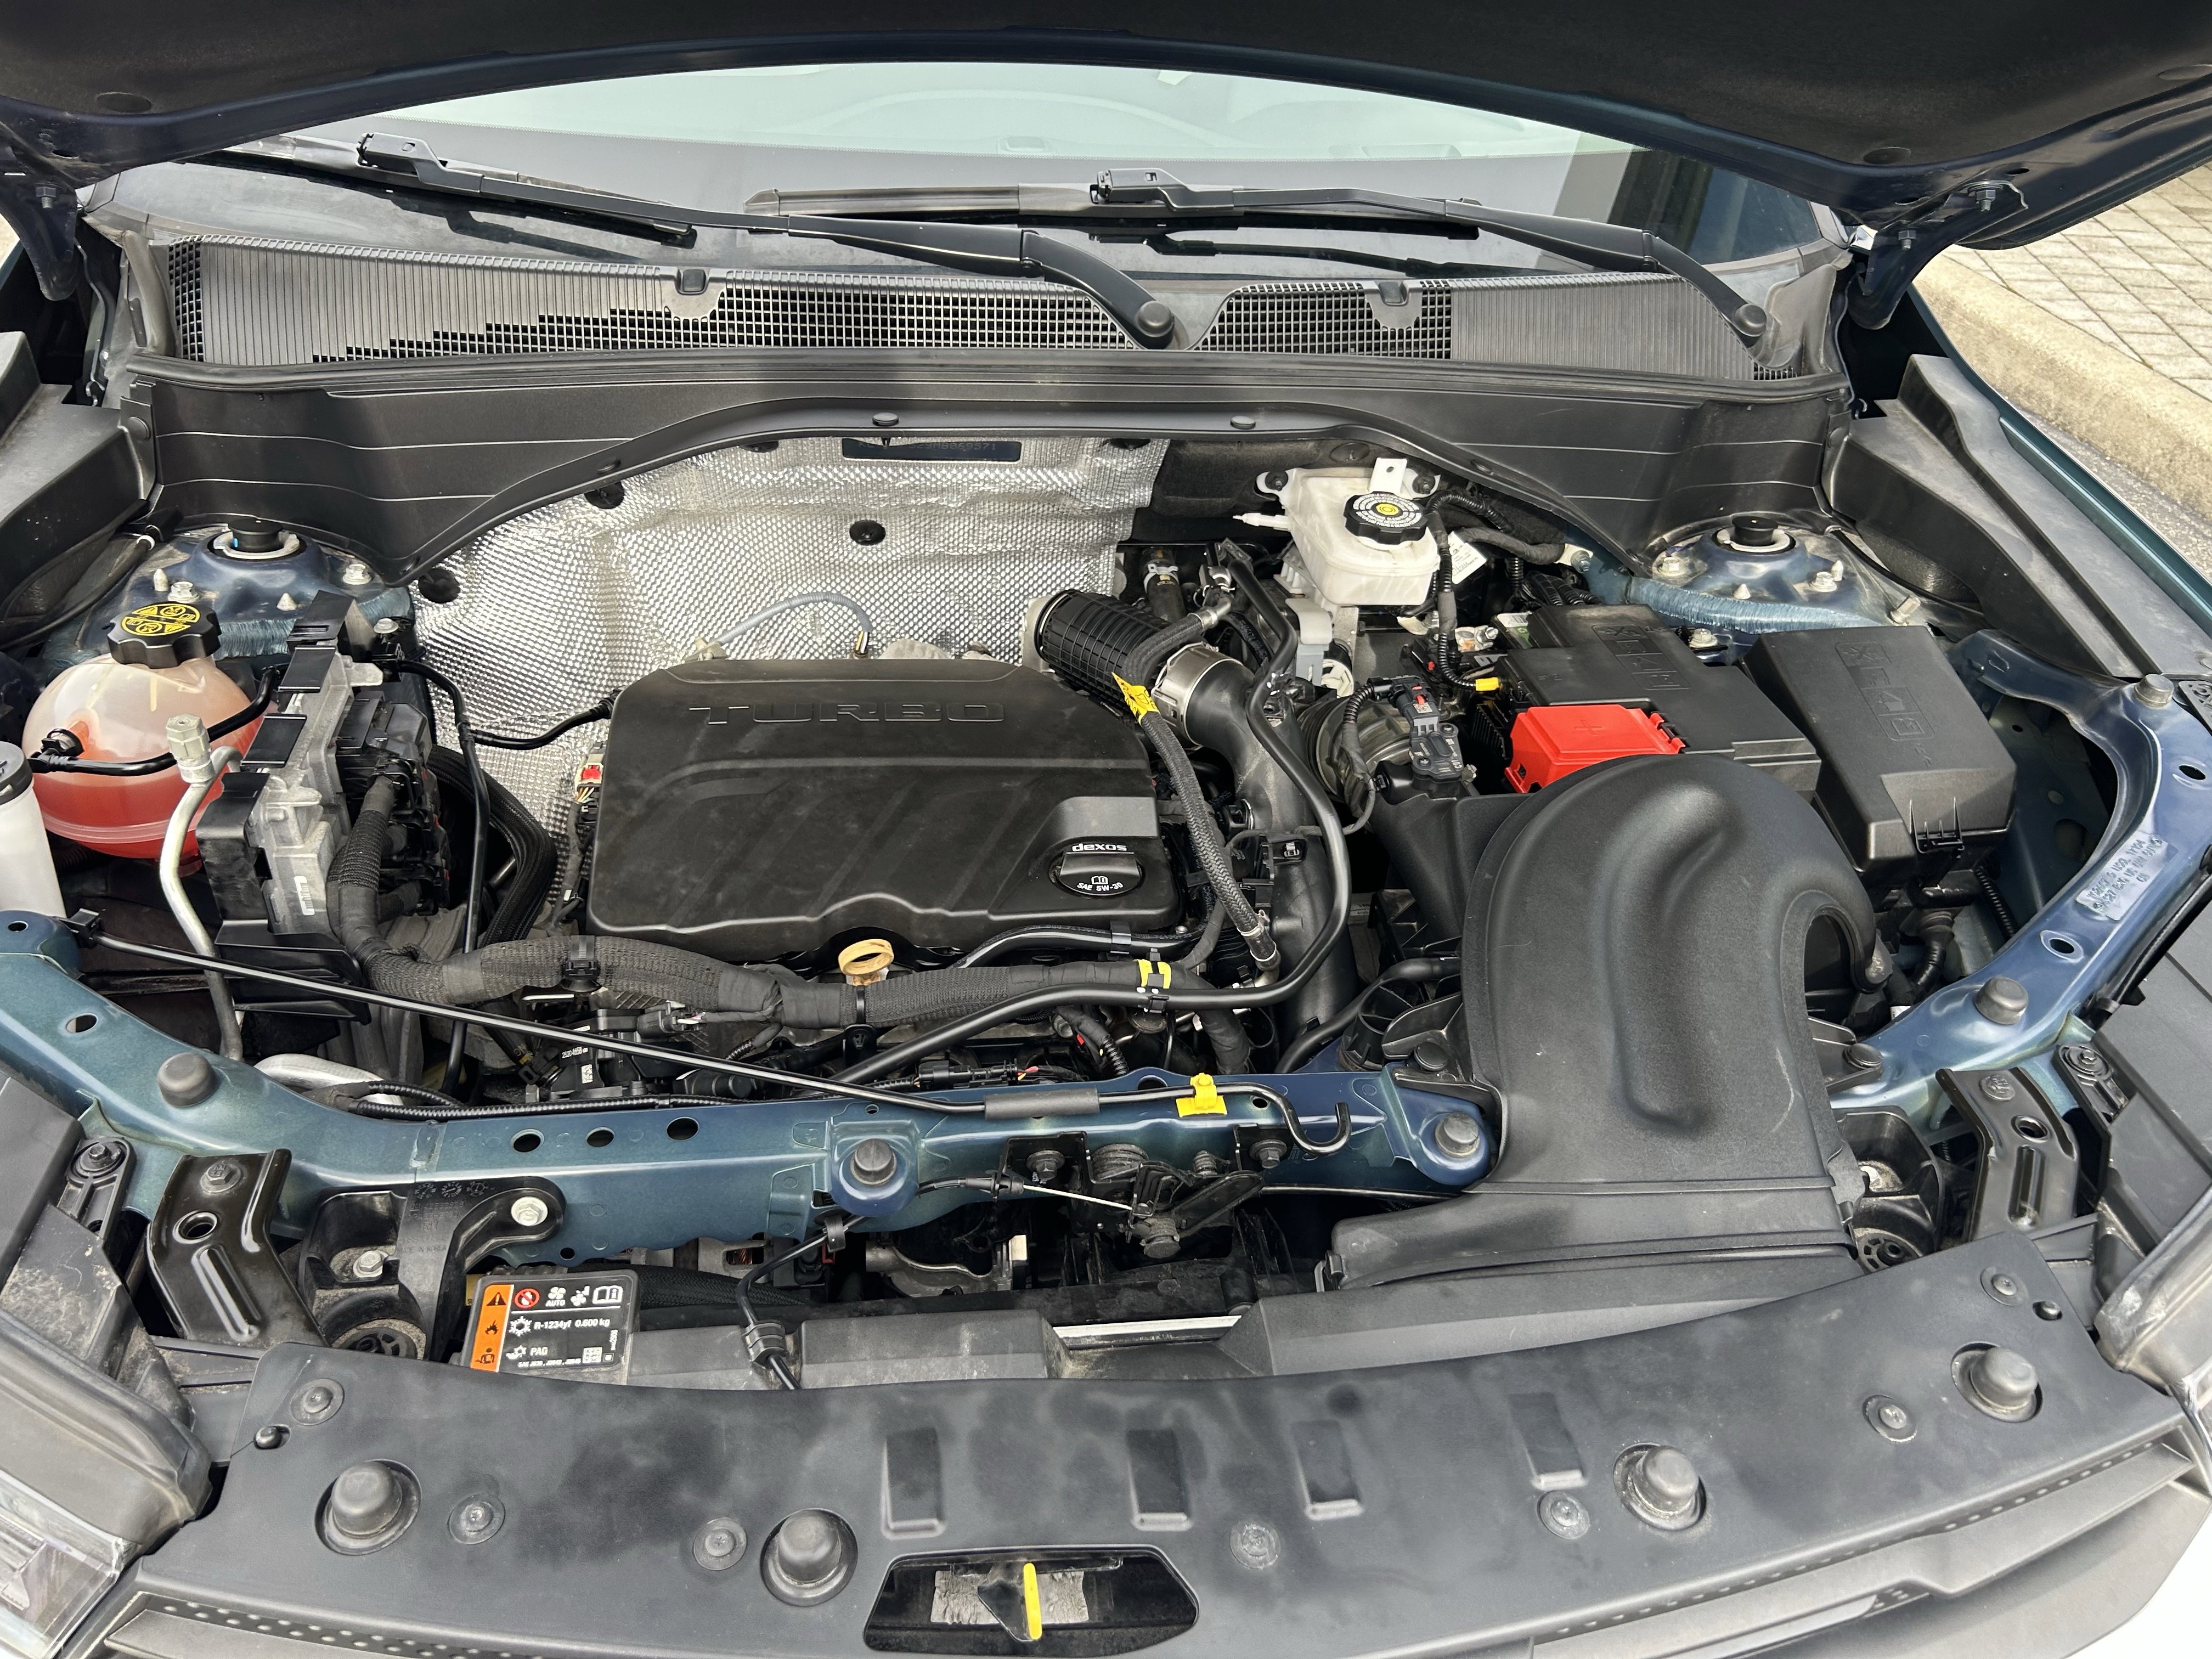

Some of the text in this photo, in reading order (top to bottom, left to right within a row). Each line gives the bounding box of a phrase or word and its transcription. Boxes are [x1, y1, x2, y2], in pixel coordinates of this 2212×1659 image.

[689, 702, 1005, 724] TURBO
[1072, 843, 1127, 851] dexos
[1076, 882, 1124, 891] SAE 5W-30
[534, 1318, 611, 1330] R-1234yf 0.600 kg
[530, 1346, 548, 1356] PAG
